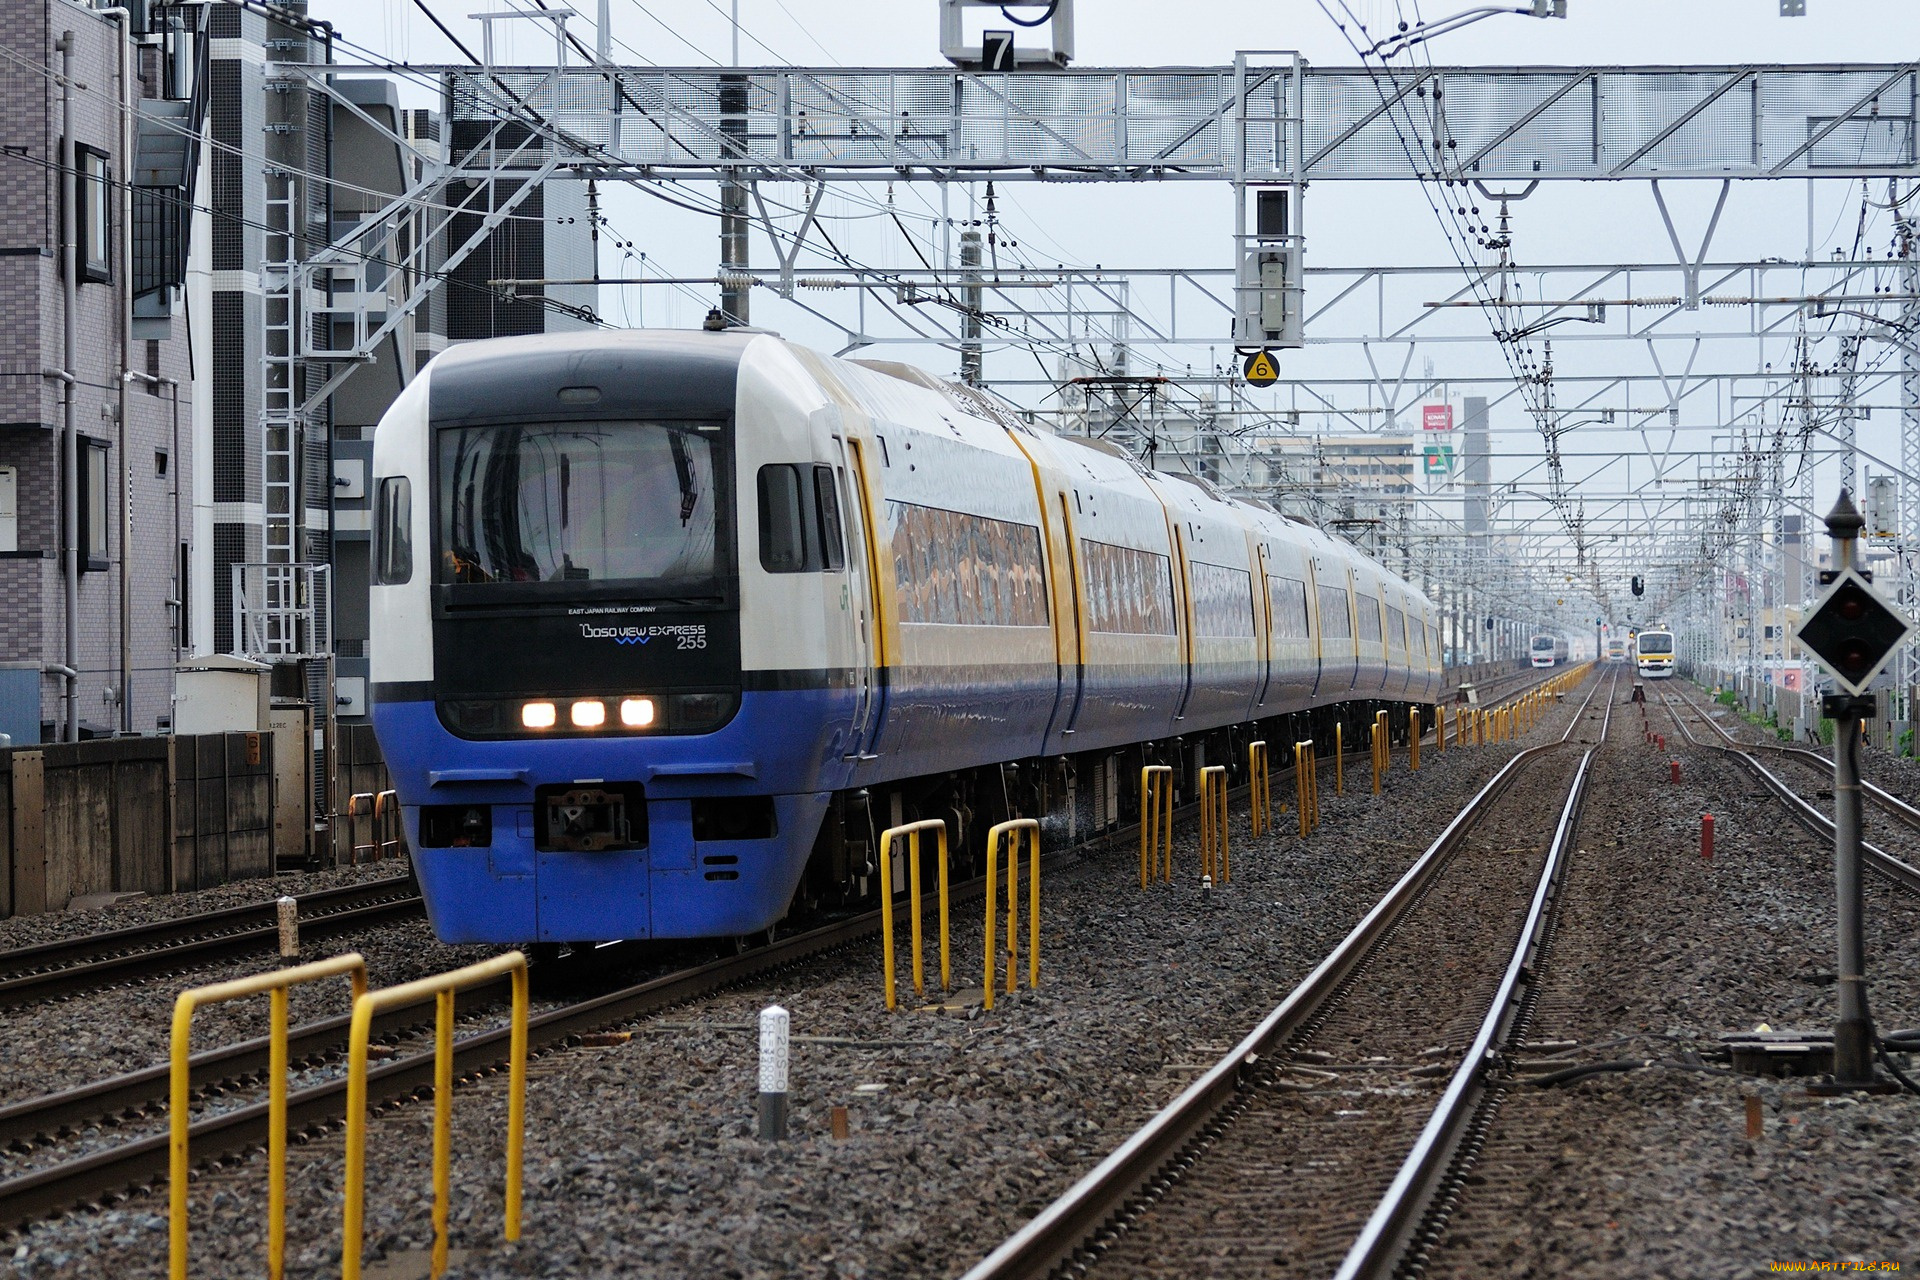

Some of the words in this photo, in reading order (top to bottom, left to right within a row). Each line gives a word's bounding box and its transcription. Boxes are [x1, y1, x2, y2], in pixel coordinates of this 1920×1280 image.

[985, 32, 1012, 70] 7
[1256, 363, 1268, 377] 6
[839, 584, 850, 611] JR
[584, 607, 604, 615] JAPAN
[604, 606, 629, 614] RAILWAY
[618, 626, 647, 637] VIEW
[648, 624, 706, 636] EXPRESS
[677, 635, 707, 650] 255
